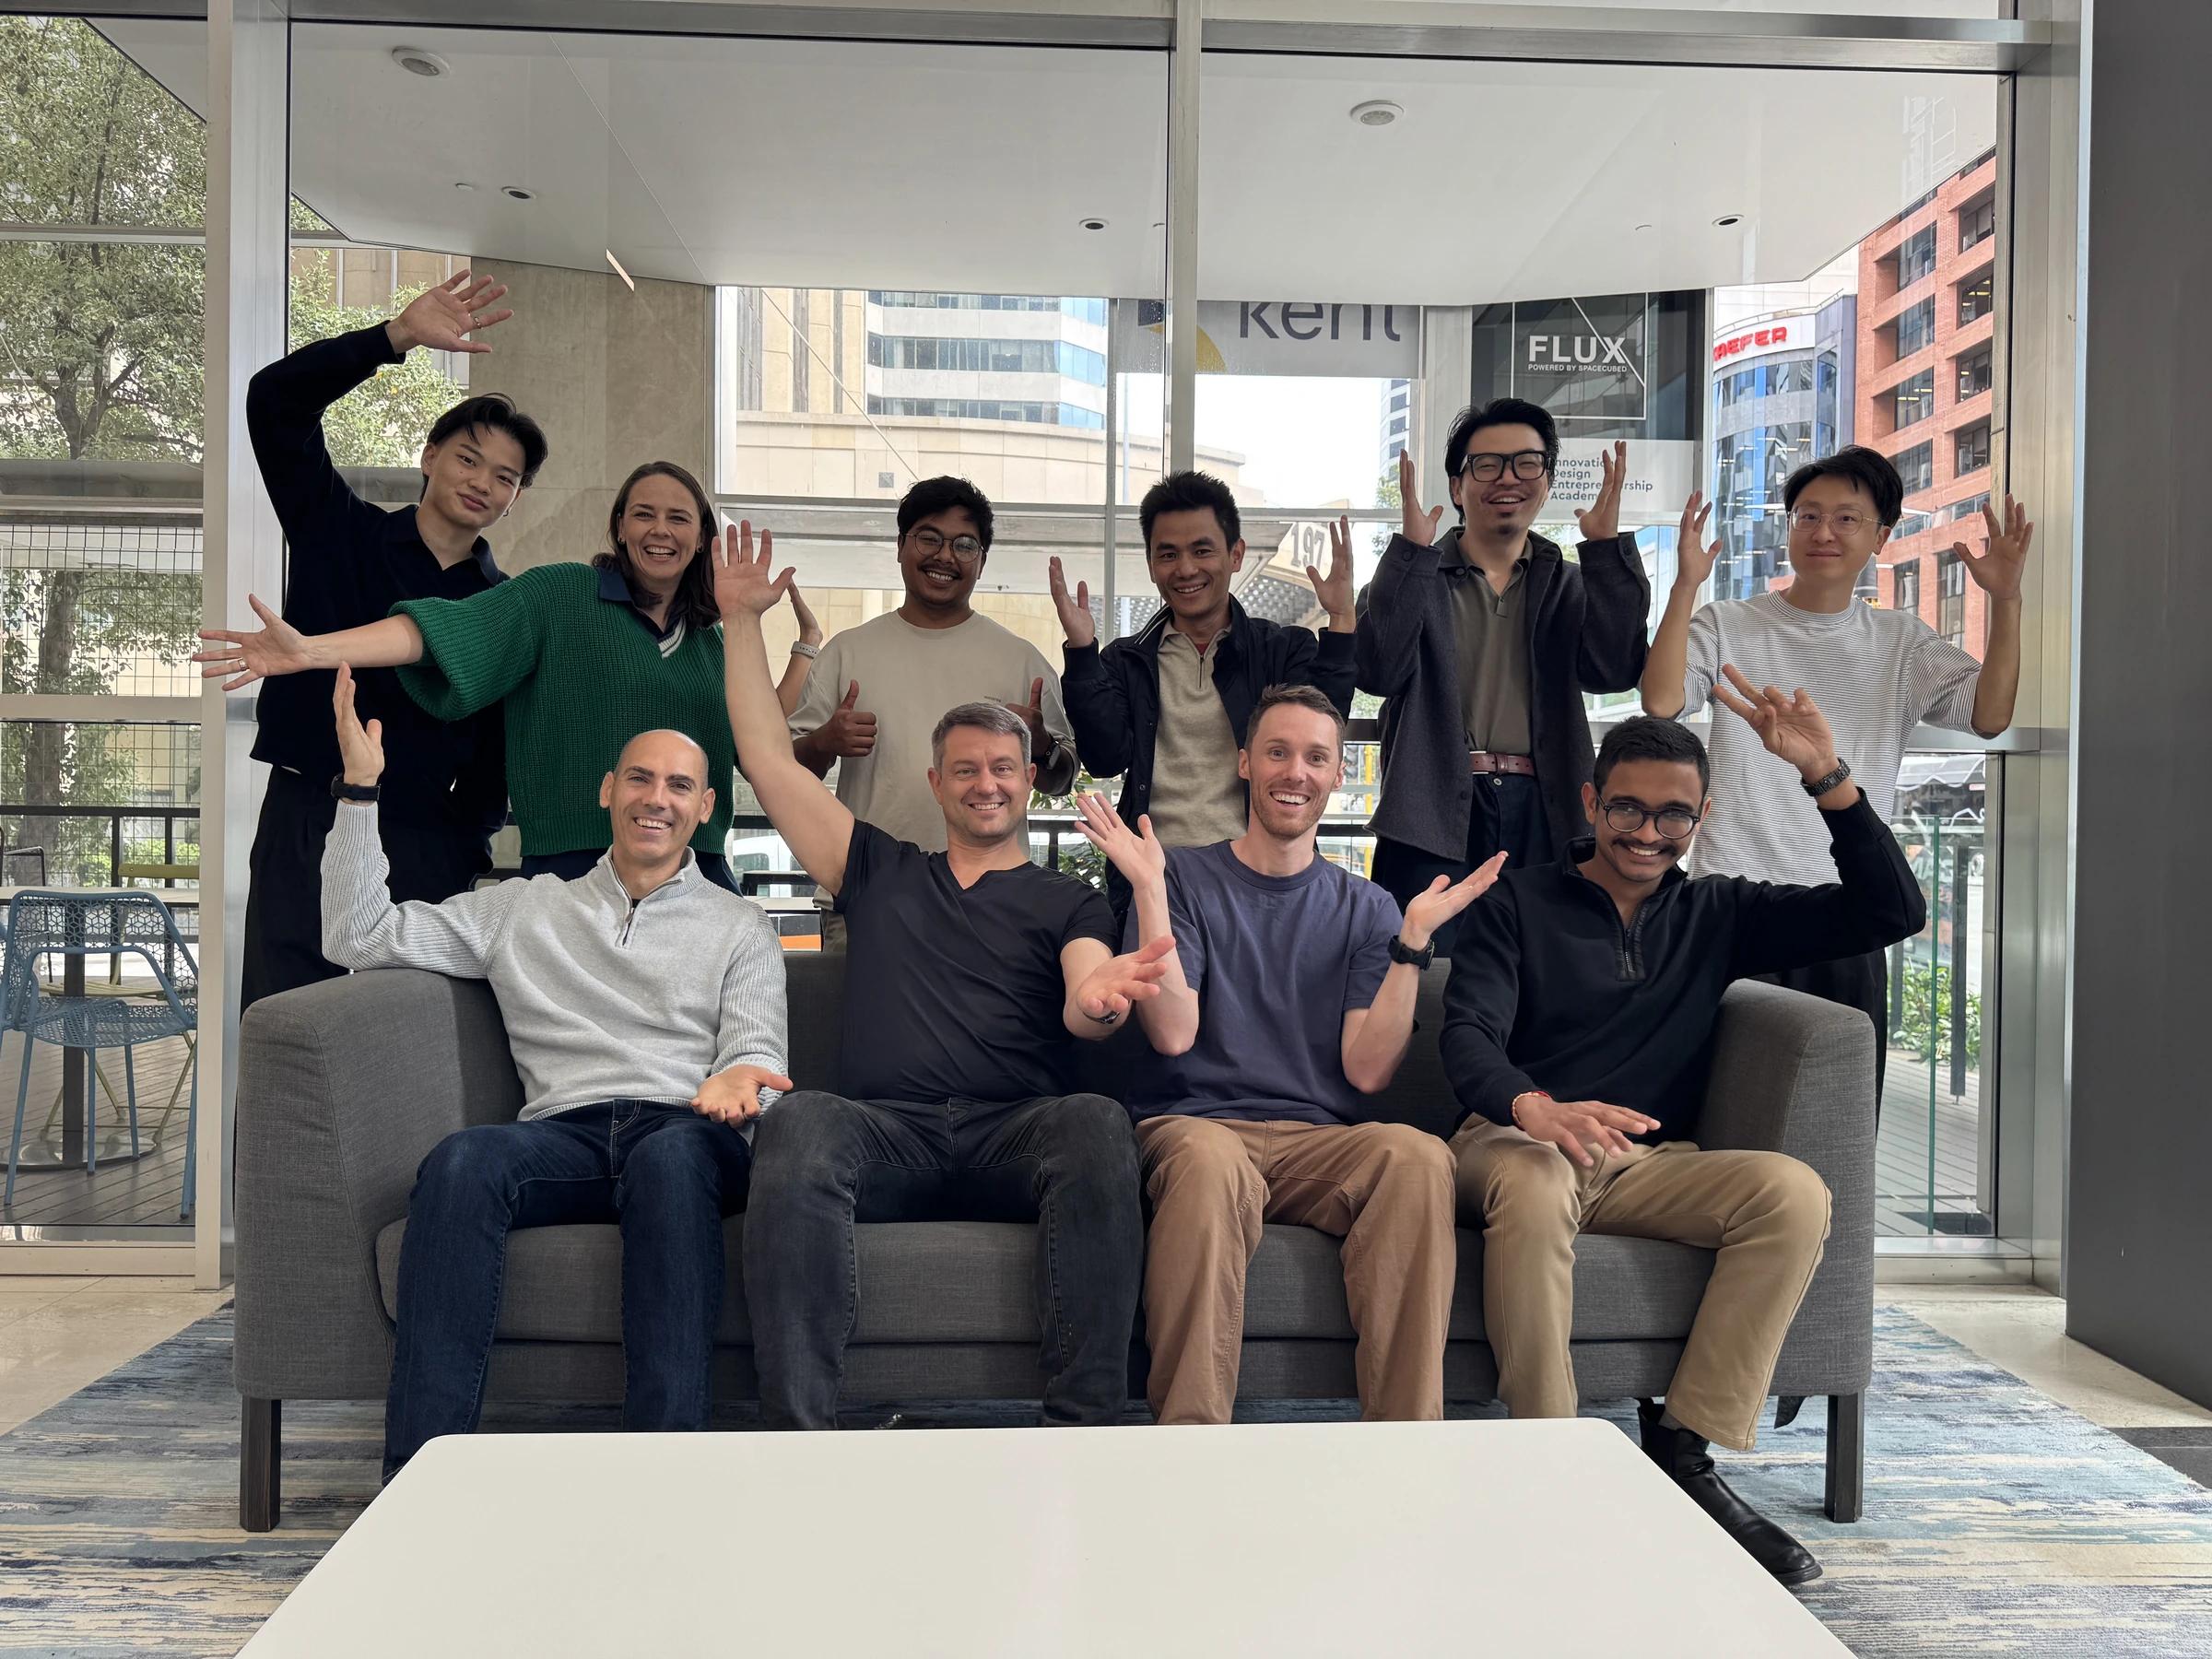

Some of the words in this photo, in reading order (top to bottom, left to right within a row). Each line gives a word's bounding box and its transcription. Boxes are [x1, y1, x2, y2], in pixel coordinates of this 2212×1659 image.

[1529, 335, 1626, 364] FLUX
[1712, 326, 1787, 362] AEFER
[1528, 363, 1564, 371] POWERED
[1550, 490, 1597, 500] Academ
[1551, 479, 1653, 492] Entreprership
[1290, 522, 1325, 571] 197
